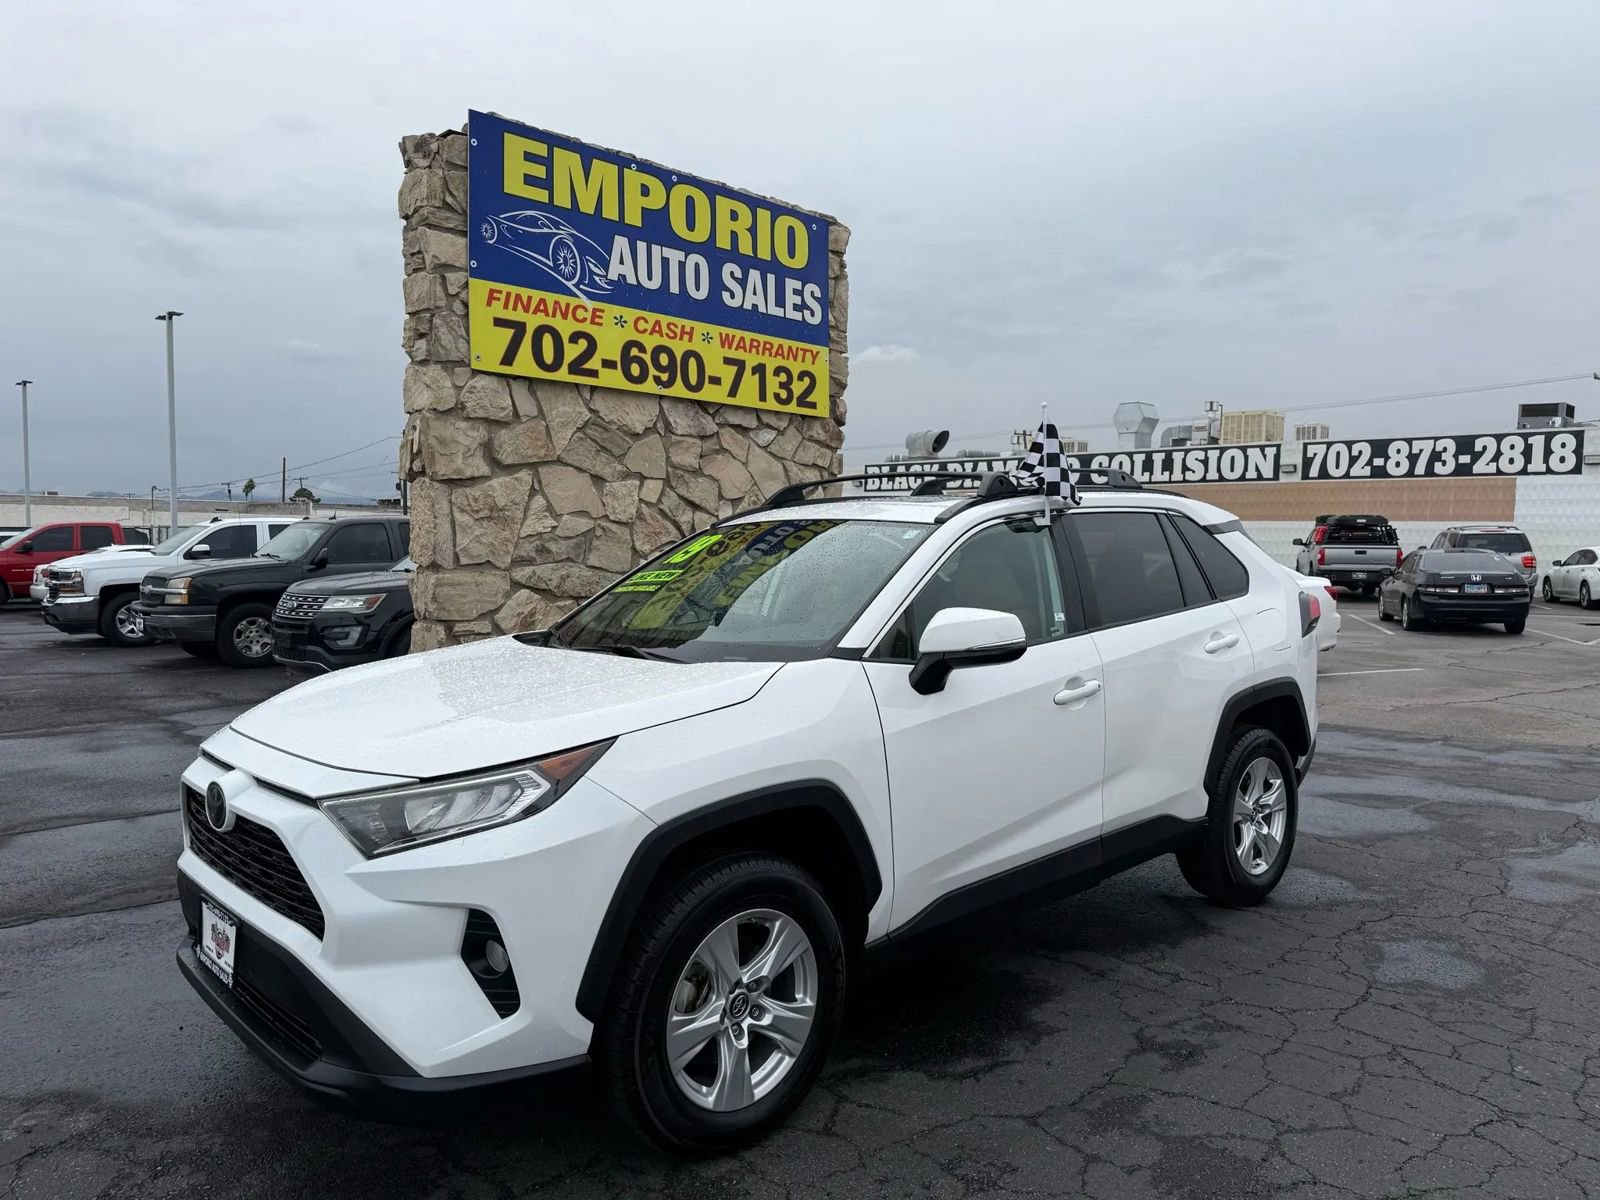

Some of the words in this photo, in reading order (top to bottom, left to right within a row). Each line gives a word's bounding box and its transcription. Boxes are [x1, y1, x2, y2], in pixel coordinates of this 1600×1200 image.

[503, 131, 809, 269] EMPORIO
[607, 234, 710, 300] AUTO
[721, 262, 822, 325] SALES
[486, 288, 606, 327] FINANCE
[633, 316, 695, 343] CASH
[719, 332, 820, 365] WARRANTY
[493, 317, 818, 410] 702-690-7132
[946, 457, 1080, 488] DIAMD
[1090, 447, 1277, 484] COLLISION
[1306, 433, 1577, 478] 702-873-2818
